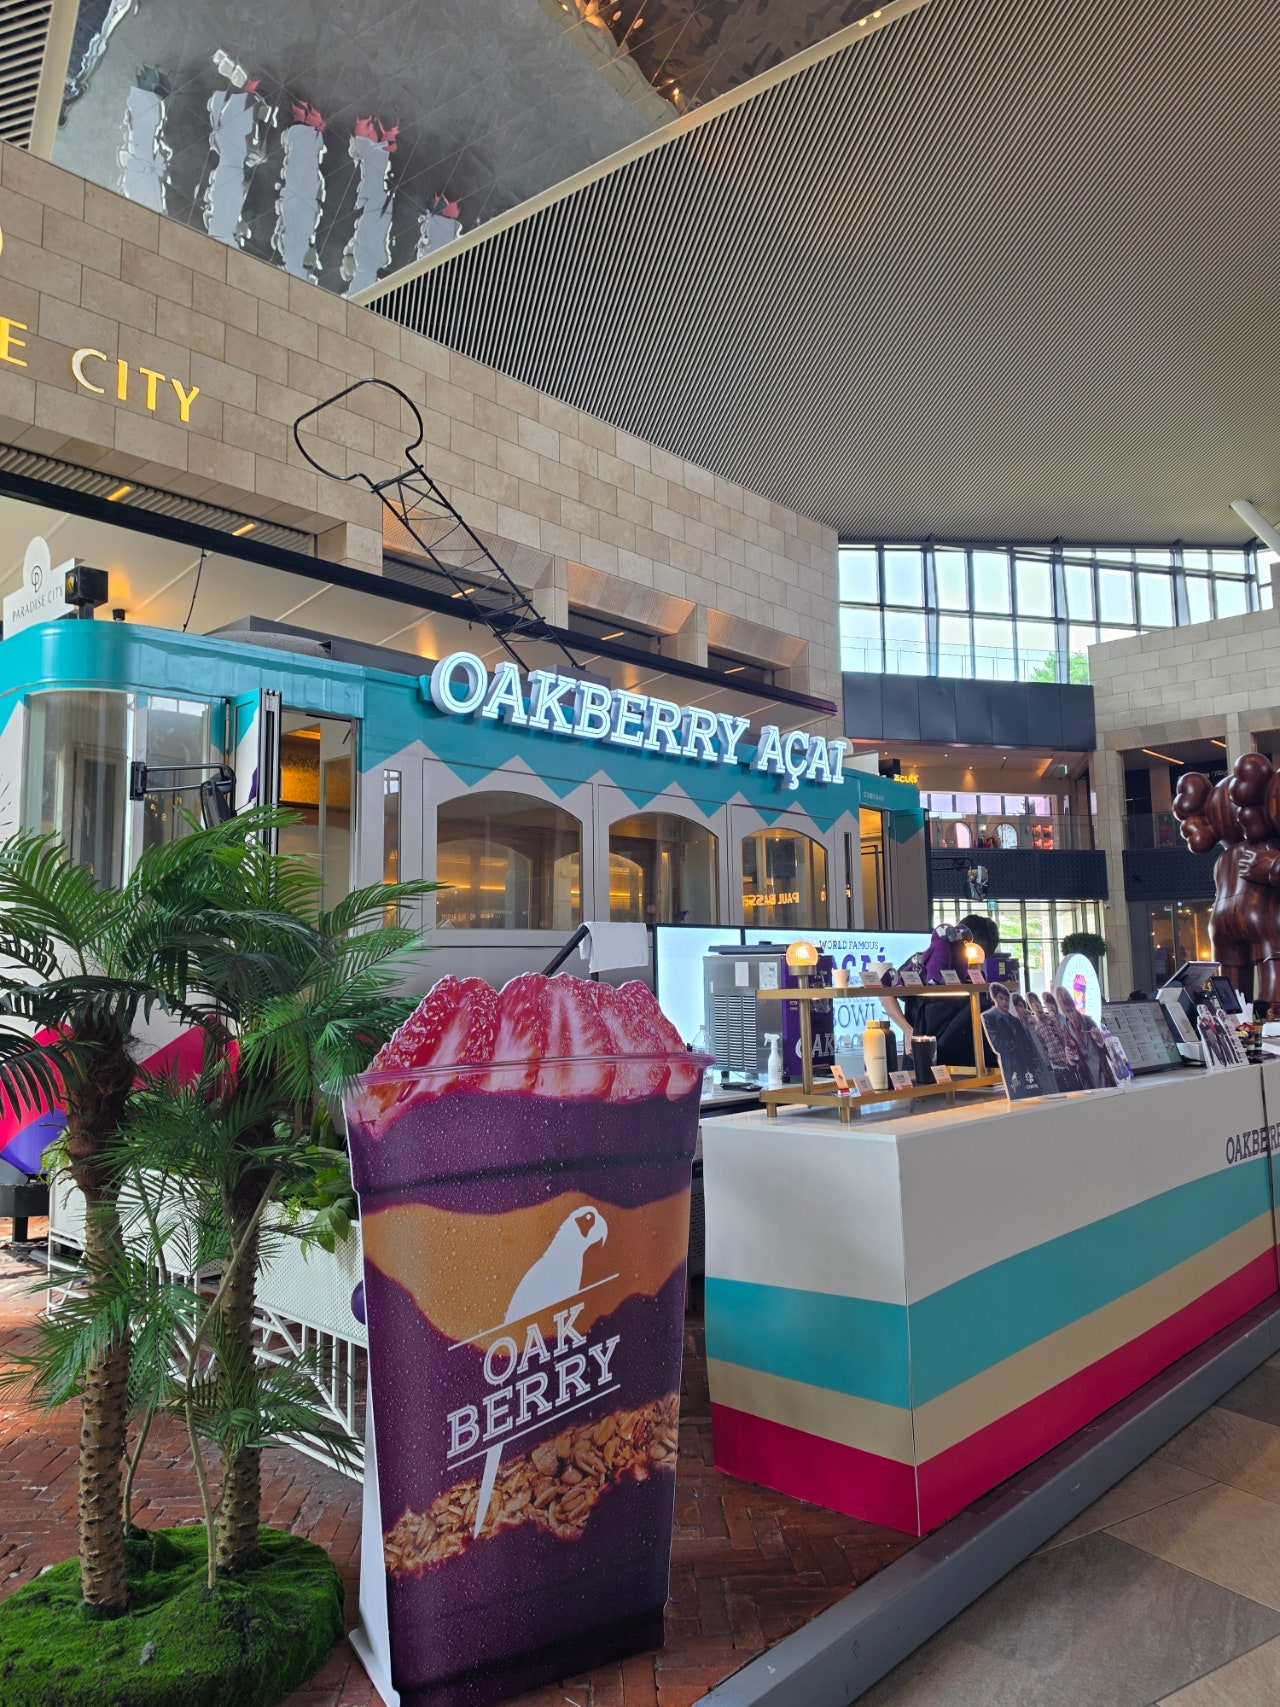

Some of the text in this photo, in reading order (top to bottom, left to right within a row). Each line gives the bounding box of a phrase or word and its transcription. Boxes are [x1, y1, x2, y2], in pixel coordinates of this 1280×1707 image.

[71, 348, 200, 423] CITY
[12, 584, 65, 622] PARADISE CITY
[433, 652, 750, 765] OAKBERRY
[819, 940, 879, 950] WORLD FAMOUS
[483, 1302, 587, 1386] OAK
[447, 1335, 621, 1459] BERRY
